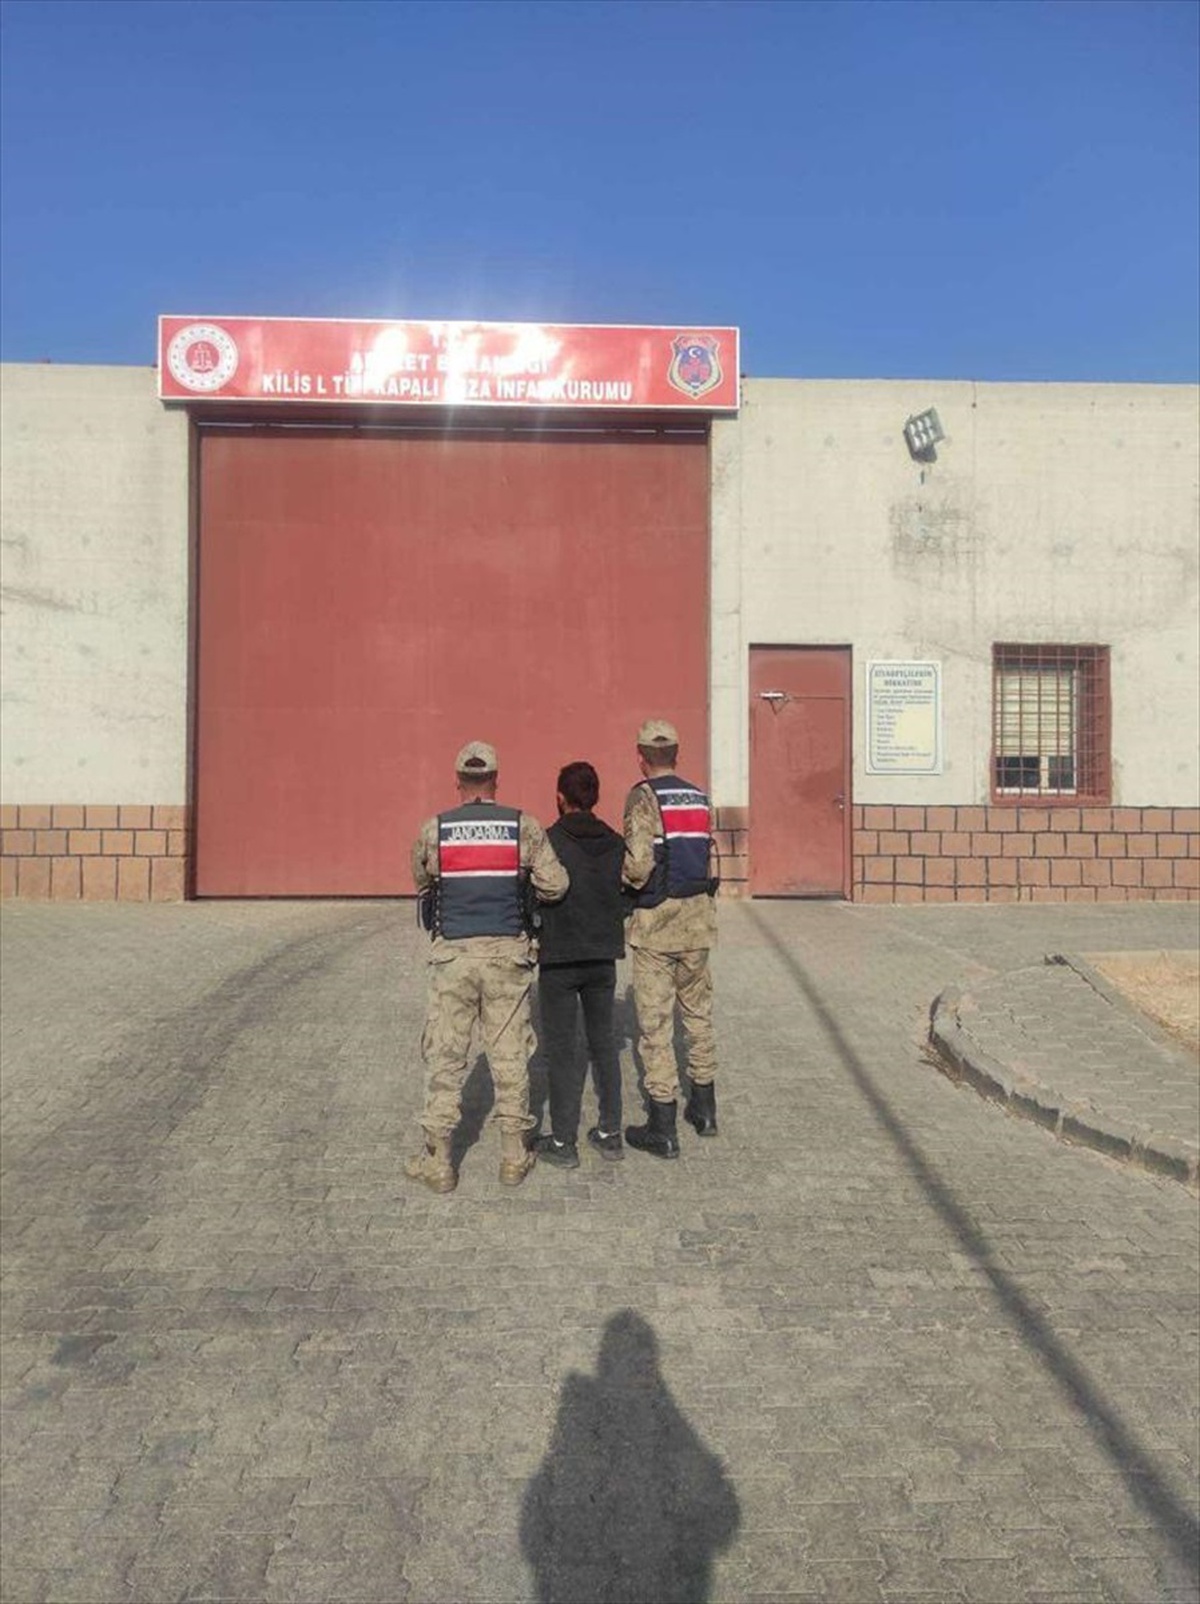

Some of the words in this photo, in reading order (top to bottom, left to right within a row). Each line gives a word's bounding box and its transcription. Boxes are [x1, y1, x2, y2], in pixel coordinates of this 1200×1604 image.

[262, 369, 311, 393] KİLİS
[317, 376, 327, 393] L
[445, 377, 491, 398] ZA
[496, 375, 546, 399] İNFA
[554, 380, 632, 401] KURUMU
[447, 825, 511, 841] JANDARMA
